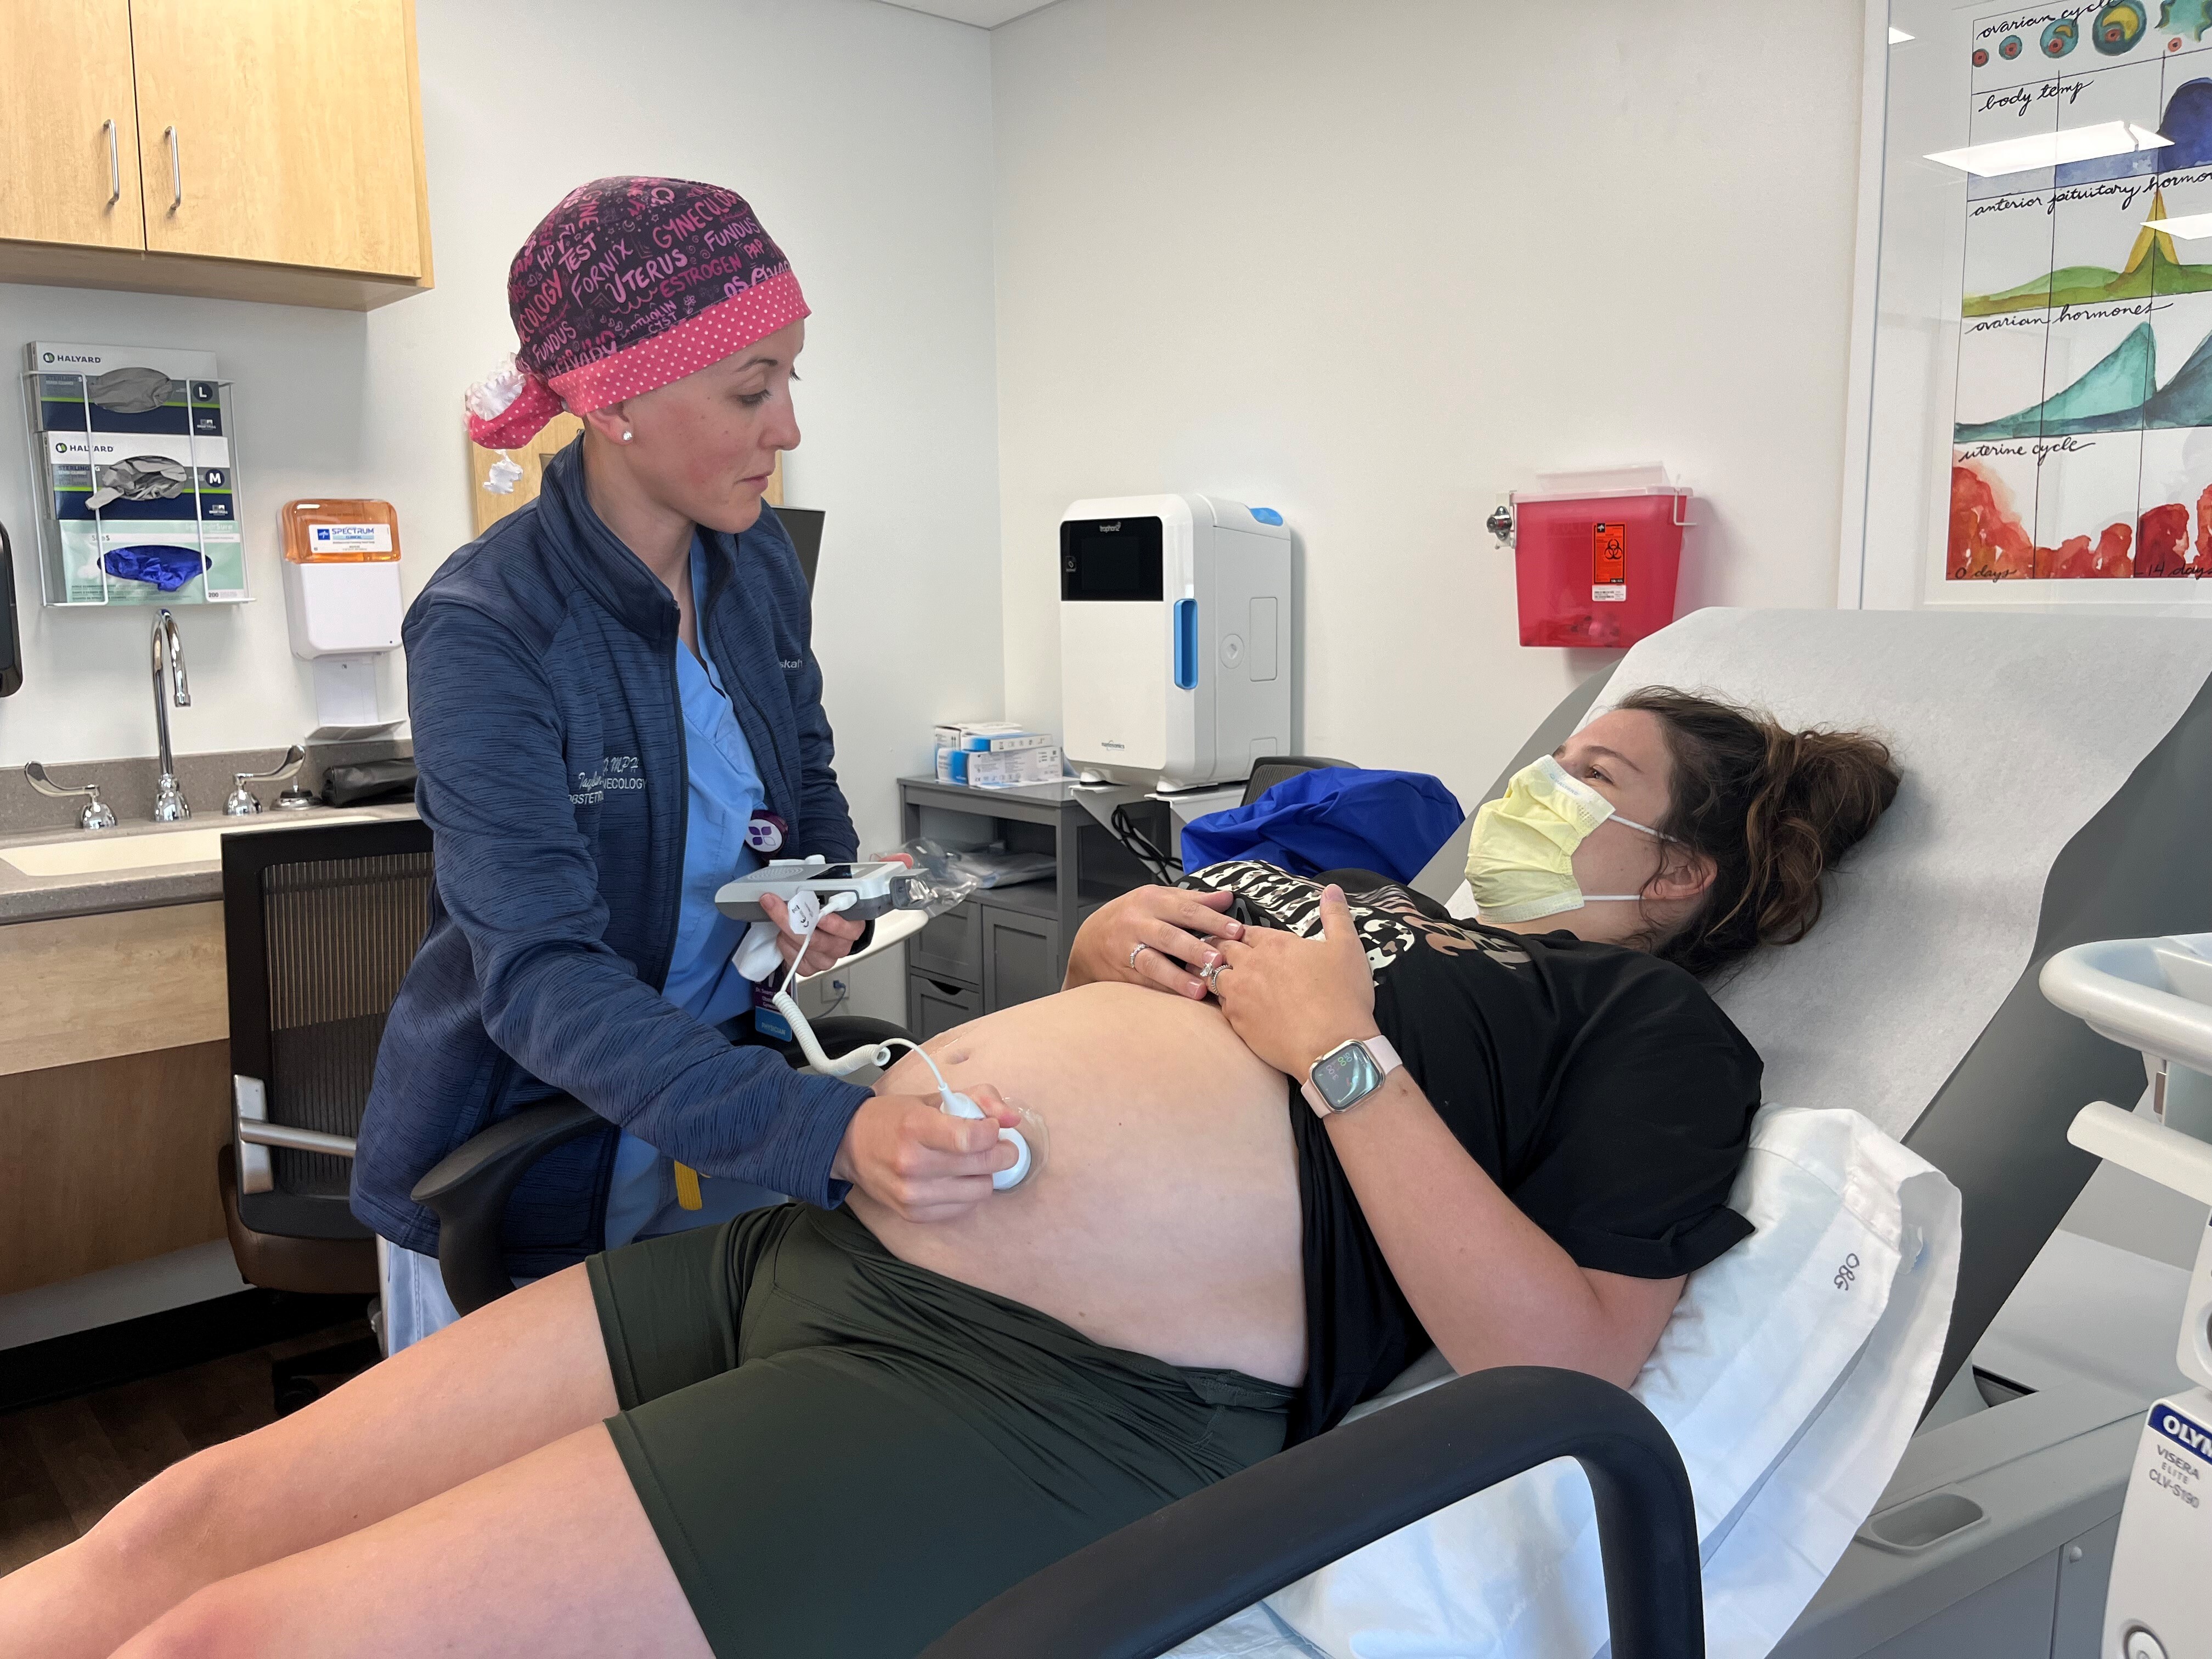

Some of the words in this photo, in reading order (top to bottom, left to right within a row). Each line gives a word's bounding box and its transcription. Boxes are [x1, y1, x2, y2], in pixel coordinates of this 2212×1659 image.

[1976, 14, 2056, 40] ovarian
[1978, 88, 2031, 116] body
[2037, 80, 2094, 104] temp
[1969, 196, 2043, 218] anterior
[2047, 185, 2141, 215] pituitary
[704, 217, 761, 251] FUNDUS
[743, 238, 764, 259] PAP
[558, 232, 597, 274] TEST
[571, 238, 634, 309] FORNIX
[605, 249, 687, 303] UTERUS
[660, 252, 742, 297] ESTROGEN
[1965, 316, 2051, 334] ovarian
[2052, 302, 2174, 324] hormones
[57, 355, 101, 363] HALYARD
[532, 321, 577, 366] FUNDUS
[199, 386, 207, 398] L
[1959, 444, 2027, 462] uterine
[2032, 437, 2096, 466] cycle
[210, 472, 222, 484] M
[1971, 565, 2017, 582] days
[2148, 562, 2165, 577] 14
[2157, 1444, 2200, 1481] VISERA
[2161, 1462, 2188, 1485] ELITE
